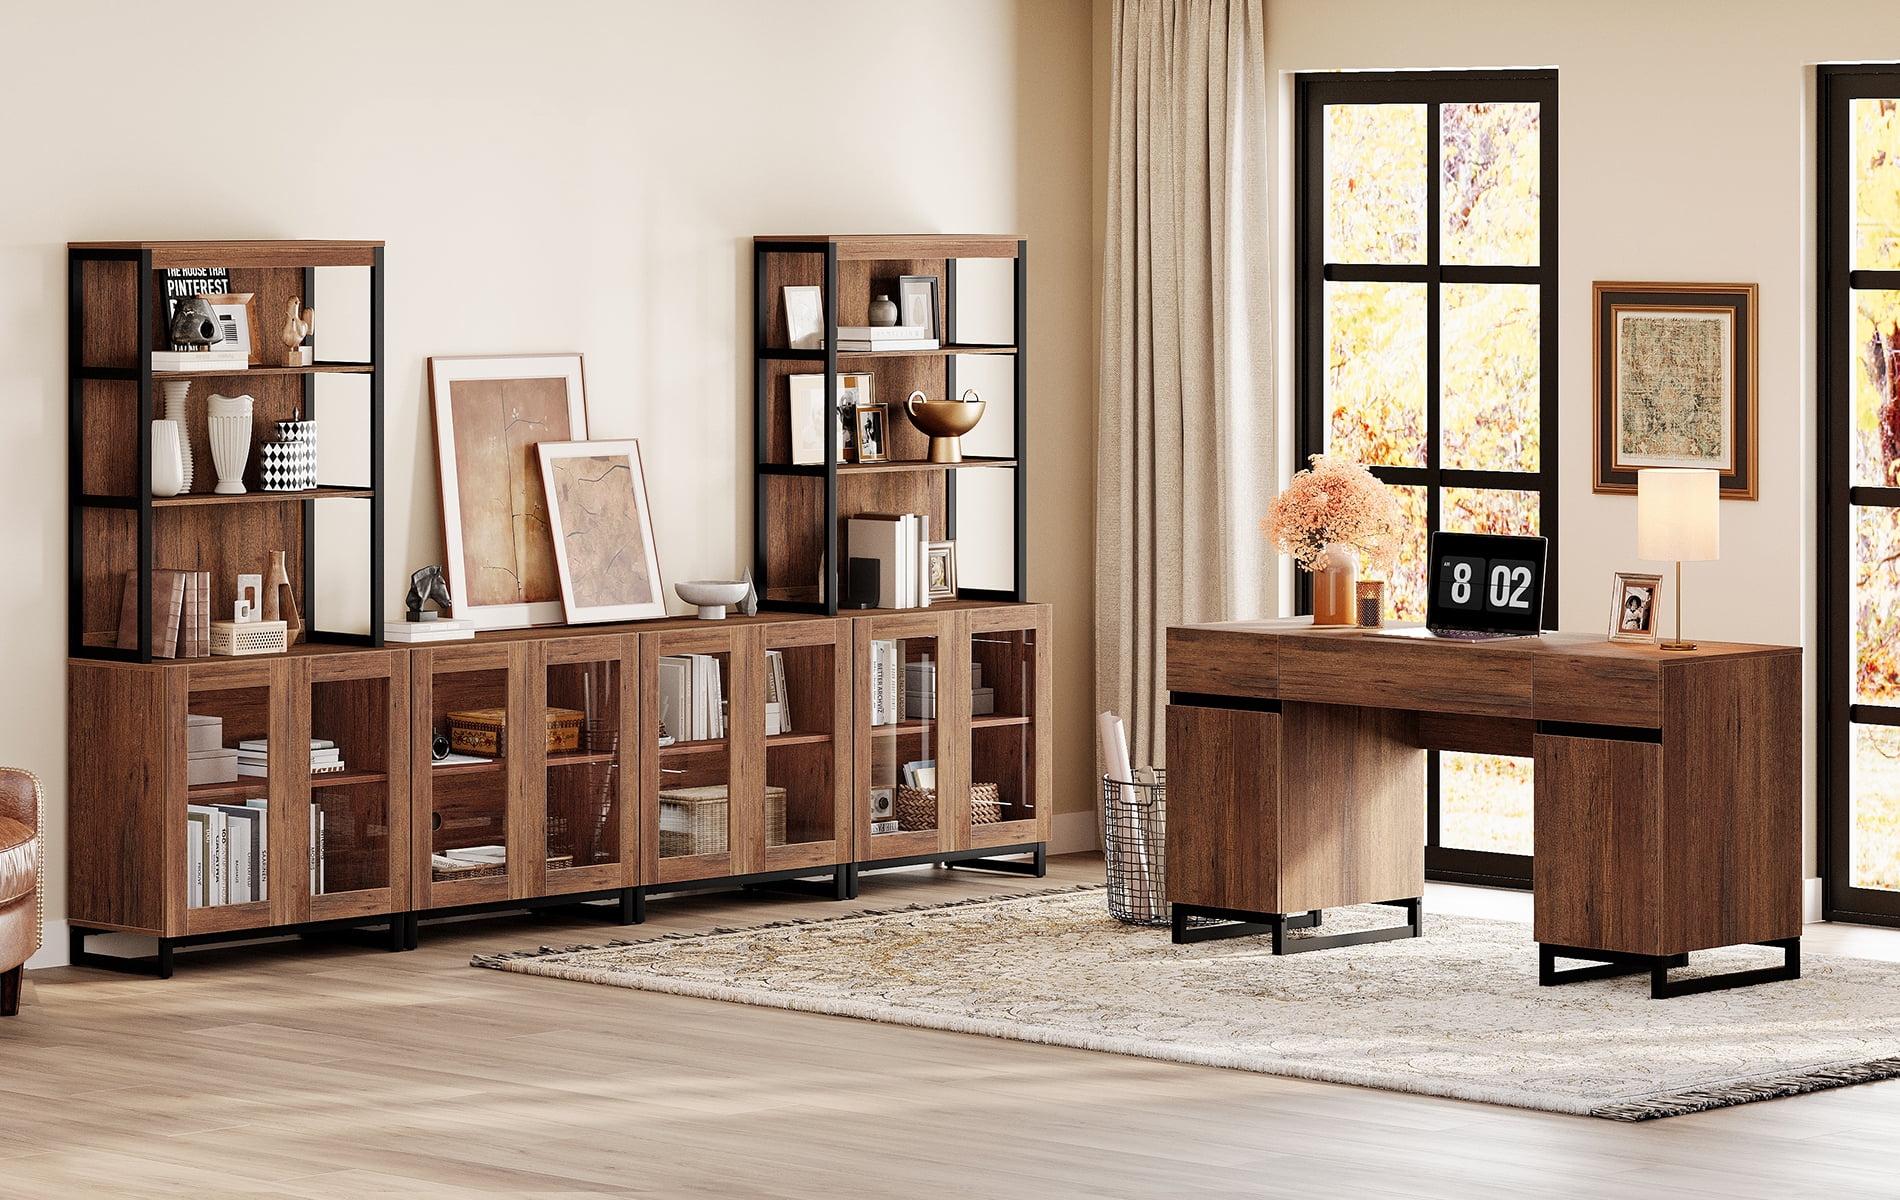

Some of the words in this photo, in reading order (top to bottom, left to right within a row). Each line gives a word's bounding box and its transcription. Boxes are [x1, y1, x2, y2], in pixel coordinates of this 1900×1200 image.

[167, 268, 181, 277] THE
[182, 268, 207, 277] HOUSE
[209, 267, 226, 276] THAT
[167, 278, 228, 296] PINTEREST
[1451, 562, 1472, 604] 8
[1490, 565, 1532, 609] 02
